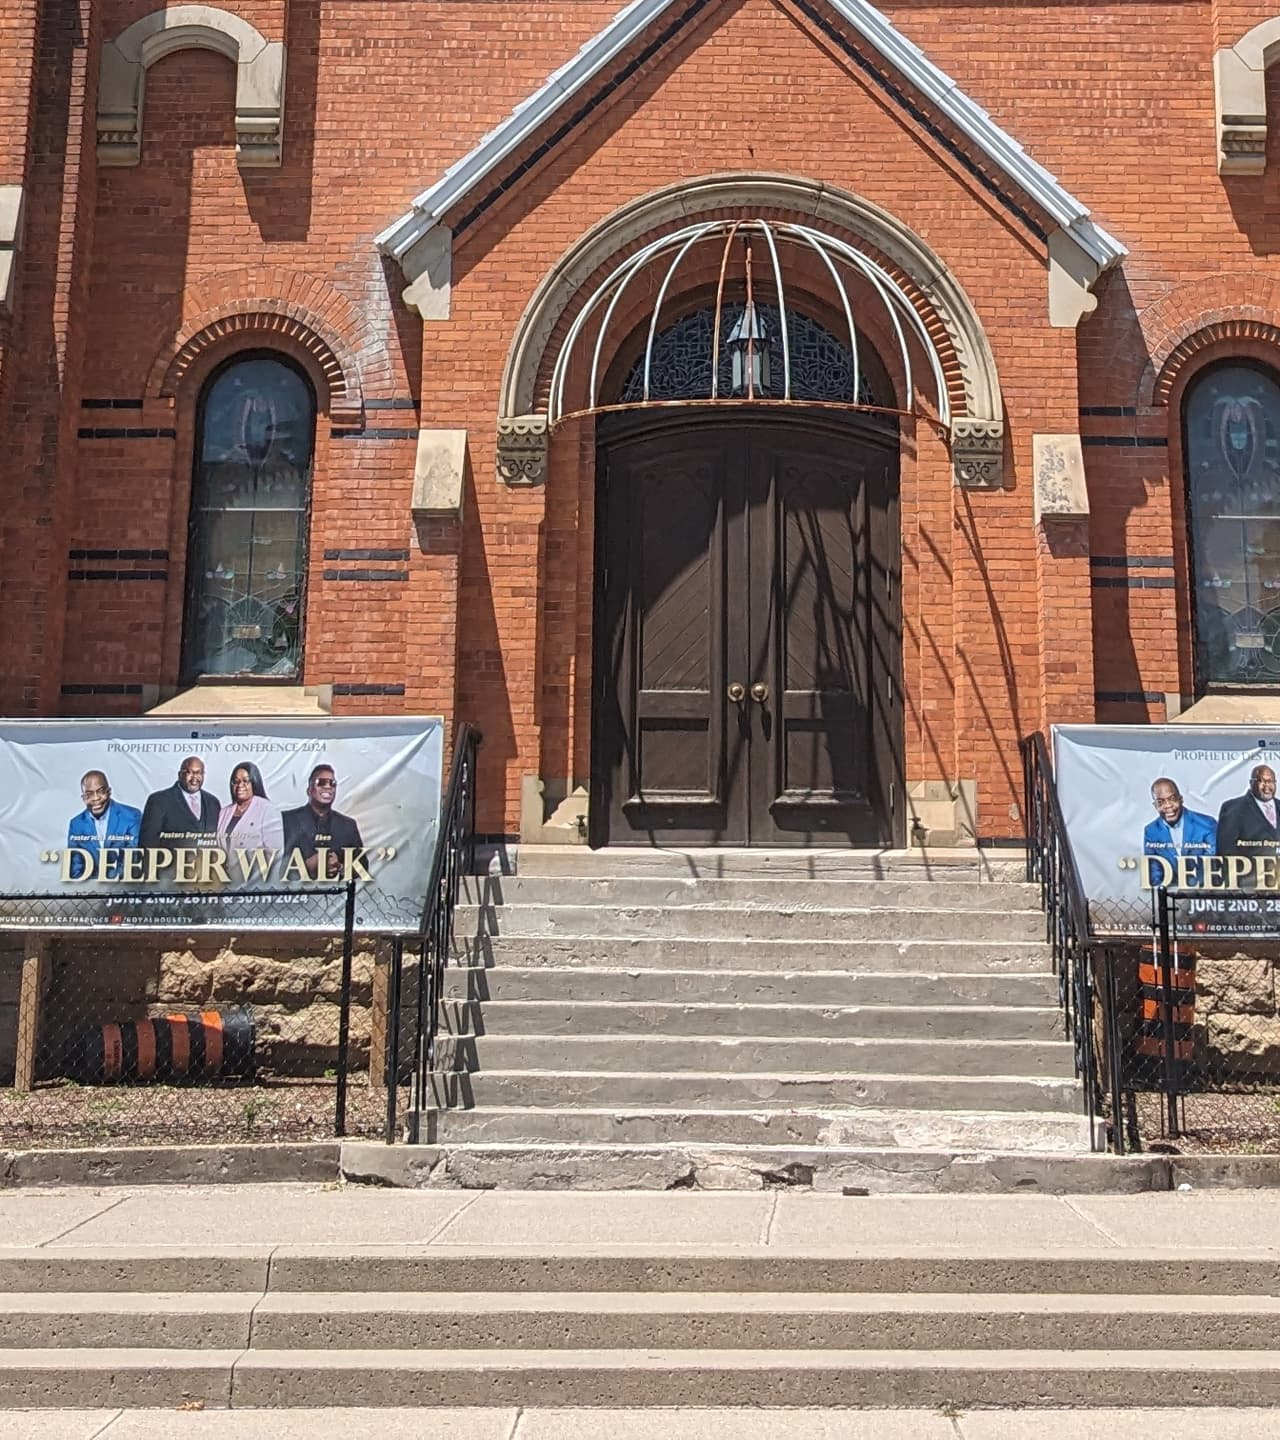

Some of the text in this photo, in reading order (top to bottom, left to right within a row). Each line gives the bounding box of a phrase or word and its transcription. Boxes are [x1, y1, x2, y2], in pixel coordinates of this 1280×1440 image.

[106, 742, 327, 753] PROPHETIC DESTINY CONFERENCE 2024
[1174, 751, 1239, 761] PROPHETIC
[1236, 839, 1261, 847] Pastors
[1188, 899, 1225, 914] JUNE
[1228, 899, 1263, 914] 2ND,
